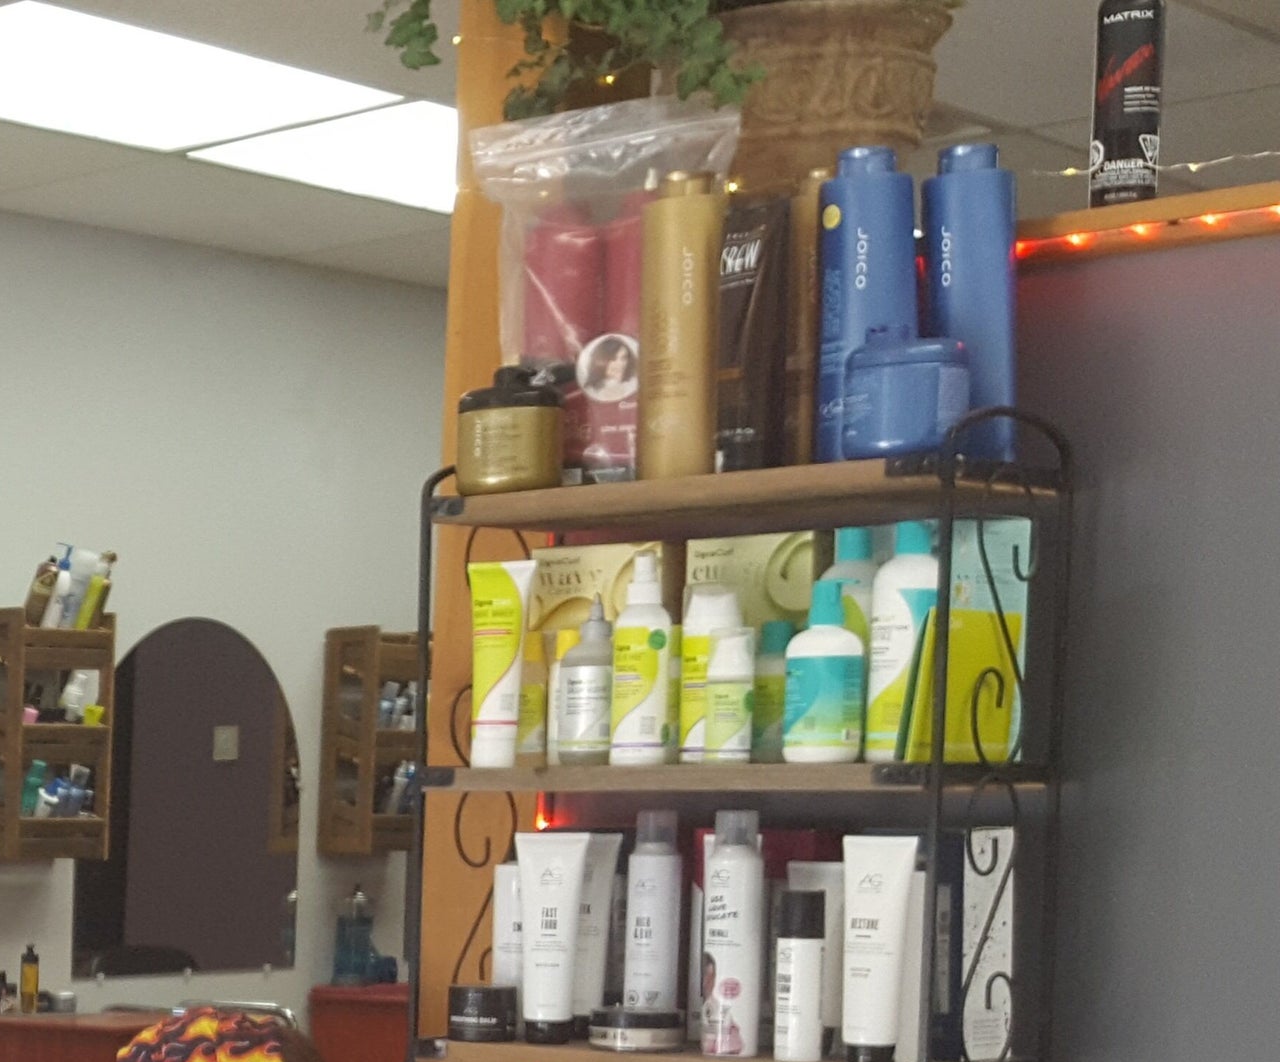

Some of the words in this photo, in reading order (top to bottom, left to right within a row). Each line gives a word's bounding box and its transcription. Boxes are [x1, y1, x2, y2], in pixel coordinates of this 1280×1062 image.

[1103, 9, 1155, 24] MATRIX
[720, 240, 763, 276] CREW
[855, 227, 869, 290] JOICO
[941, 226, 952, 288] JOICO
[682, 246, 694, 305] JOICO
[541, 867, 562, 880] AG
[711, 868, 730, 882] AG
[859, 873, 883, 888] AG
